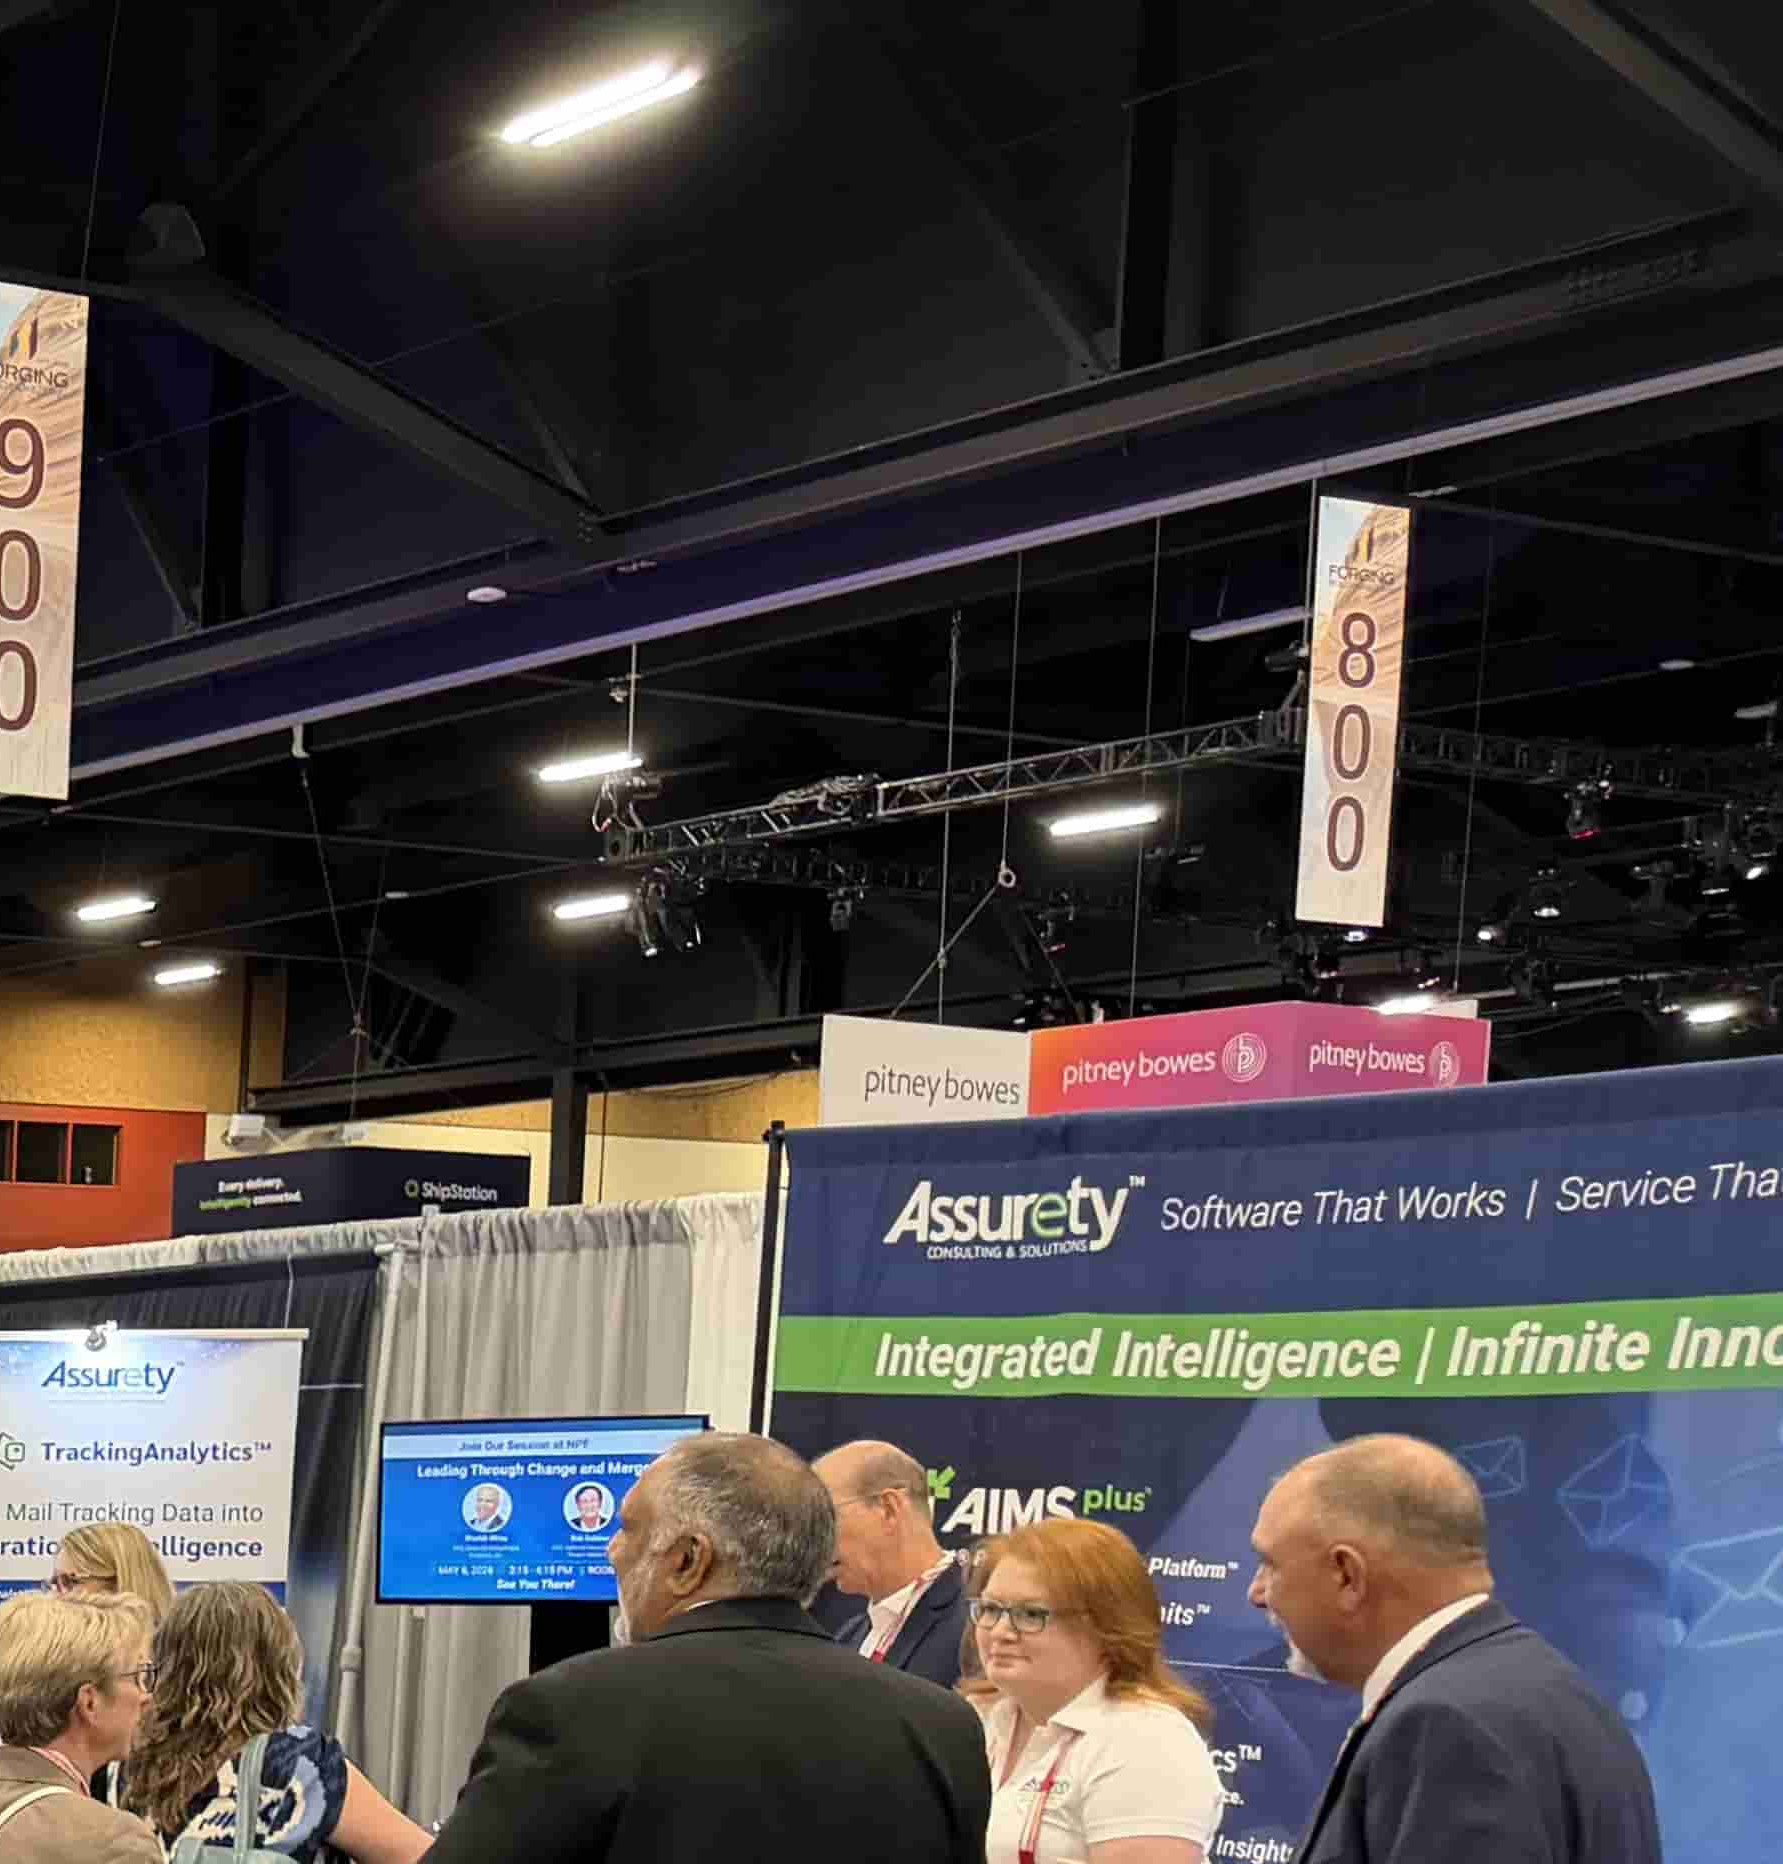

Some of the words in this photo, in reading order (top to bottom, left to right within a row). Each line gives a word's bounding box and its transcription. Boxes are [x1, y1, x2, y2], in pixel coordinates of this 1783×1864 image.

[1328, 564, 1395, 586] FORGING
[1326, 611, 1378, 872] 800
[1062, 1056, 1136, 1093] pitney
[1137, 1048, 1217, 1078] bowes
[1308, 1040, 1366, 1077] pitney
[1366, 1044, 1427, 1075] bowes
[863, 1064, 943, 1104] pitney
[944, 1074, 1020, 1106] bowes
[421, 1181, 498, 1203] ShipStation
[1159, 1193, 1303, 1232] Software
[1313, 1188, 1387, 1226] That
[1396, 1181, 1507, 1223] Works
[1554, 1169, 1697, 1213] Service
[926, 1244, 1002, 1261] CONSULTING
[1006, 1243, 1015, 1259] &
[1019, 1239, 1089, 1259] SOLUTIONS
[874, 1326, 1103, 1390] Integrated
[1112, 1326, 1402, 1392] Intelligence
[1446, 1320, 1651, 1378] Infinite
[458, 1440, 482, 1452] Join
[484, 1439, 505, 1451] Our
[506, 1439, 550, 1451] Session
[552, 1439, 564, 1450] at
[416, 1464, 468, 1480] Leading
[470, 1463, 524, 1480] Through
[527, 1462, 577, 1479] Change
[580, 1461, 606, 1475] and
[6, 1503, 53, 1523] Mail
[59, 1502, 155, 1527] Tracking
[162, 1504, 215, 1524] Data
[221, 1503, 264, 1524] into
[940, 1485, 1077, 1536] AIMS
[496, 1579, 519, 1590] See
[521, 1580, 539, 1591] You
